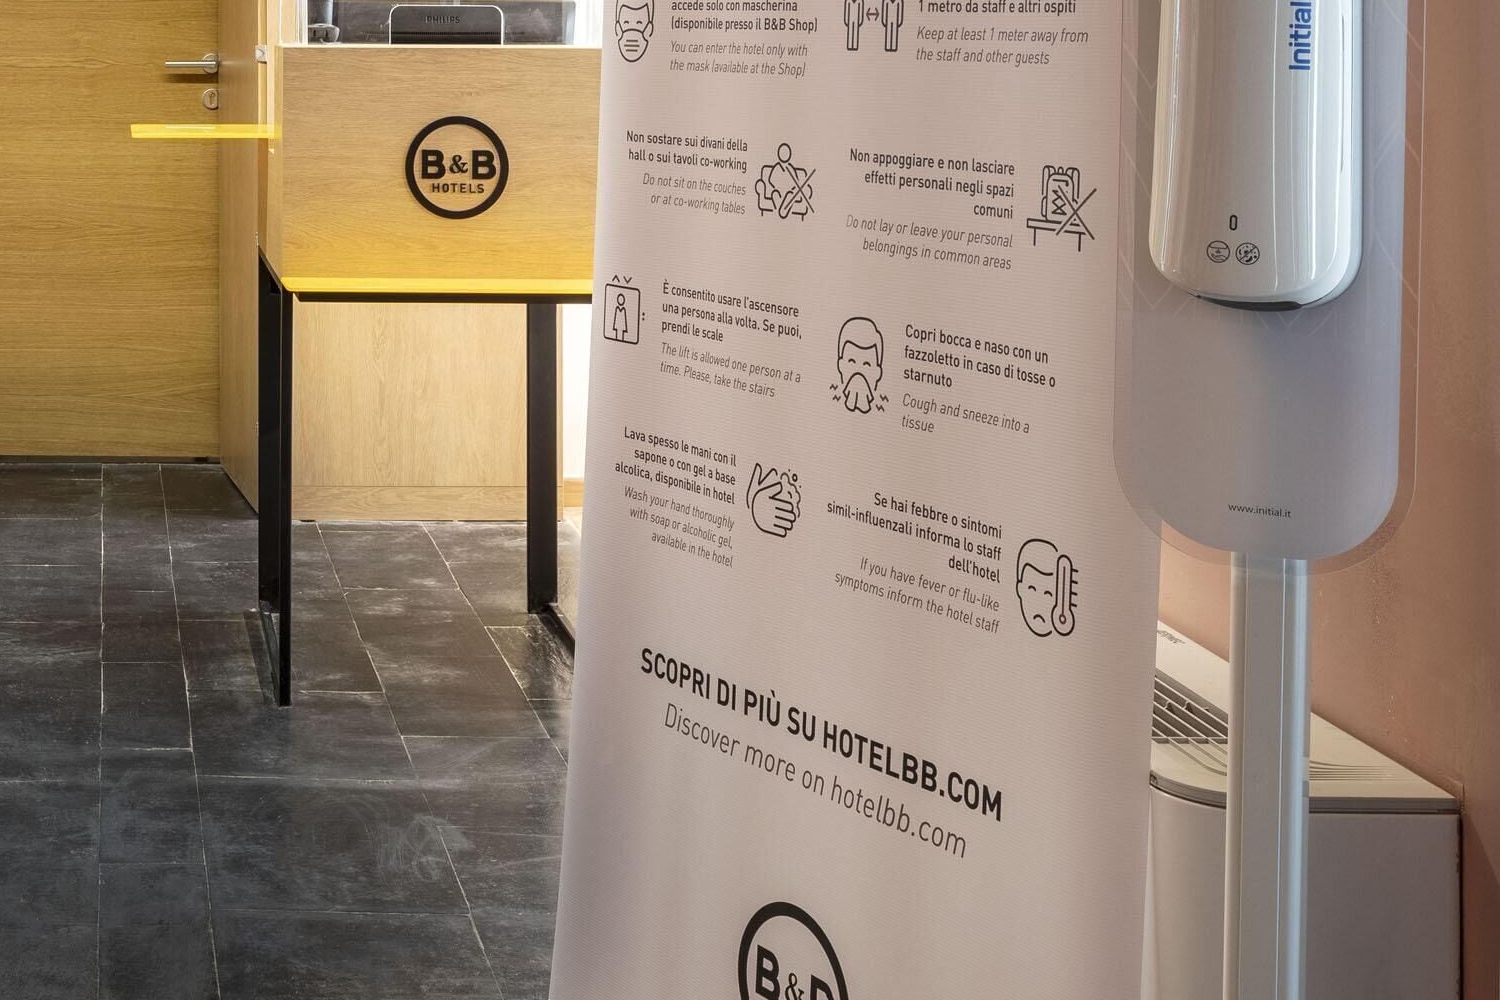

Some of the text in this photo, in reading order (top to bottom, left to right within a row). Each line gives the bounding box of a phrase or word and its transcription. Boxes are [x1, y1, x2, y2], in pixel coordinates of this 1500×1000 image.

[918, 0, 923, 13] 1
[927, 0, 962, 13] metro
[965, 0, 979, 13] da
[1008, 2, 1015, 13] e
[1289, 2, 1313, 71] Initial
[421, 149, 497, 180] B&B
[432, 183, 485, 194] HOTELS
[663, 279, 669, 295] È
[671, 286, 716, 303] consentito
[717, 294, 742, 308] usare
[661, 321, 724, 342] prendi le scale
[662, 303, 802, 340] una persona alla volta. Se puoi,
[874, 492, 1002, 539] Se hai febbre o sintomi
[1228, 504, 1292, 518] www.initial.it
[827, 500, 1002, 561] simil-influenzali informa lo staff
[641, 647, 1002, 822] SCOPRI DI PIÙ SU HOTELBB.COM
[664, 702, 966, 859] Discover more on hotelbb.com
